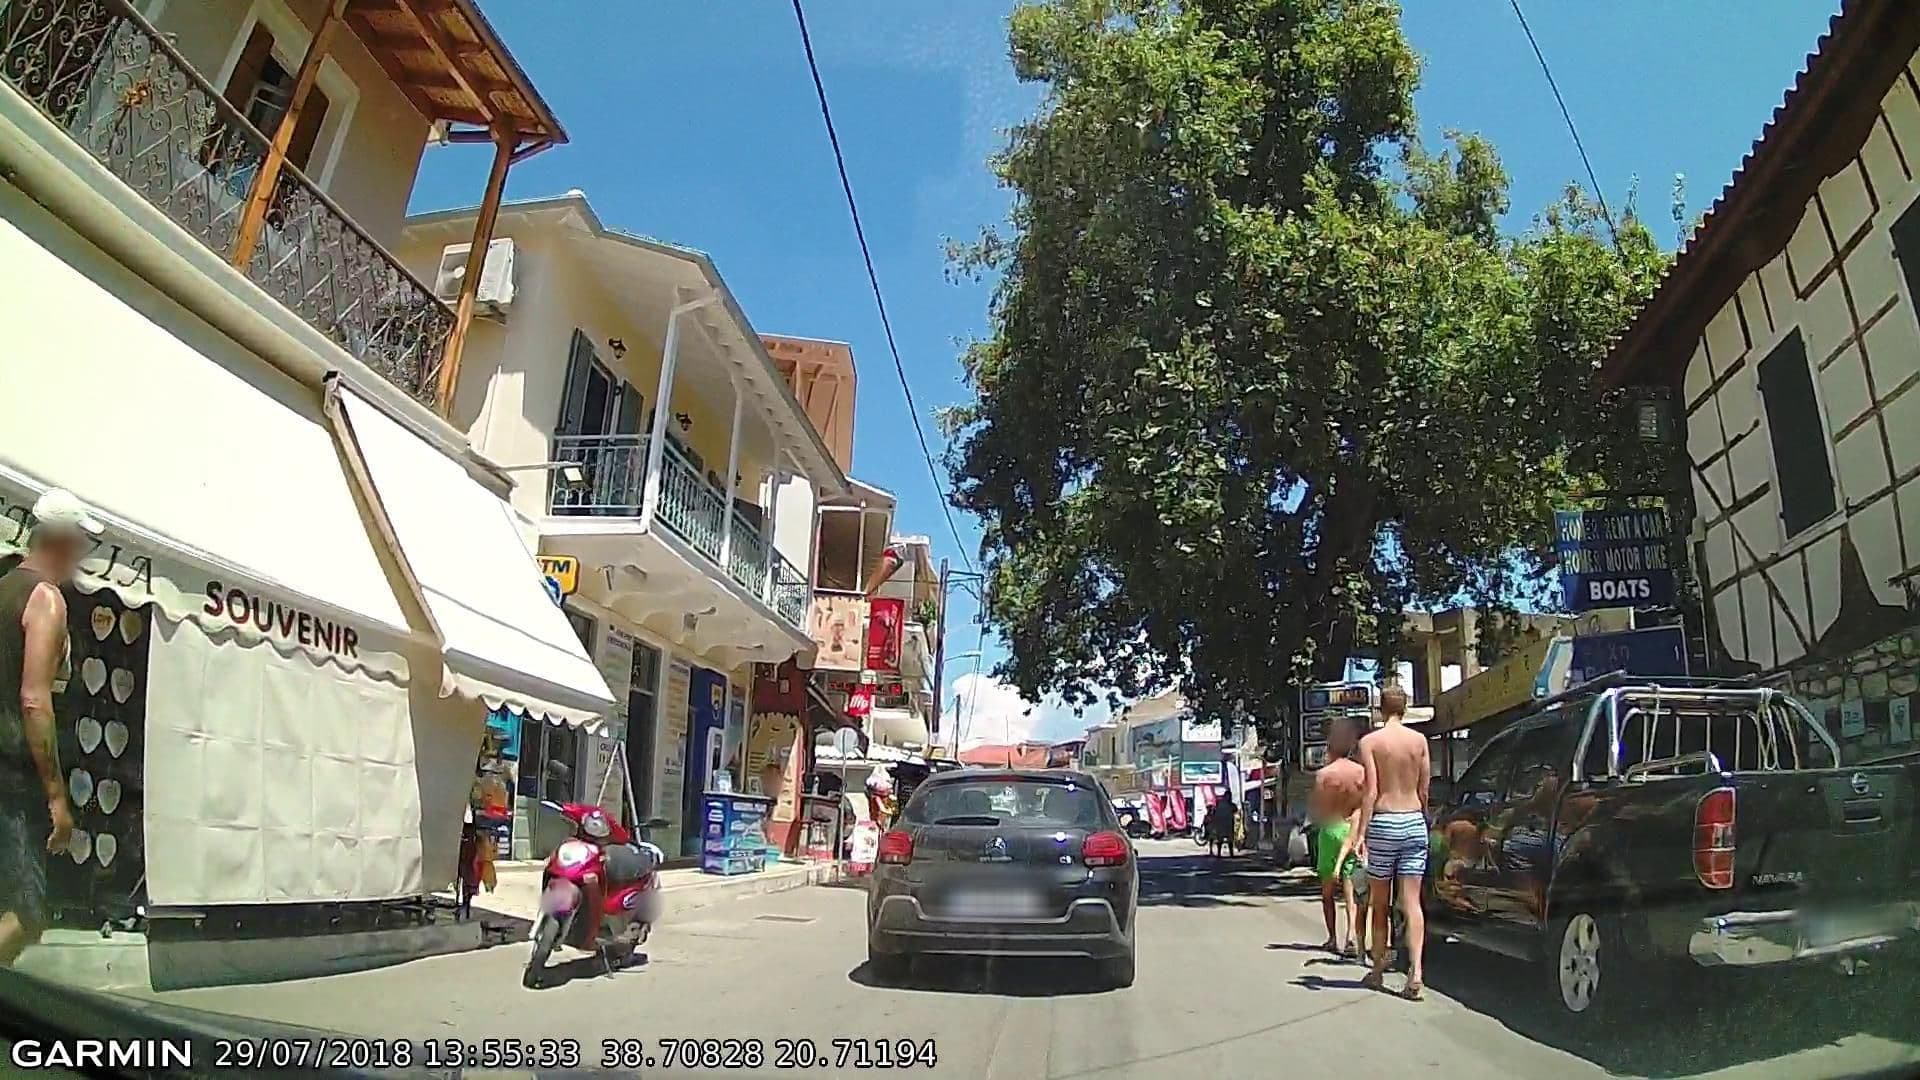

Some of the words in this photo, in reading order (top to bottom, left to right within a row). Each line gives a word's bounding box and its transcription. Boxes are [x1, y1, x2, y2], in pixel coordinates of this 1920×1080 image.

[1604, 515, 1632, 540] RENT
[1563, 548, 1601, 575] HOMER
[1604, 546, 1641, 571] MOTOR
[1644, 544, 1668, 570] BIKE
[1589, 579, 1650, 600] BOATS
[204, 580, 358, 658] SOUVENIR
